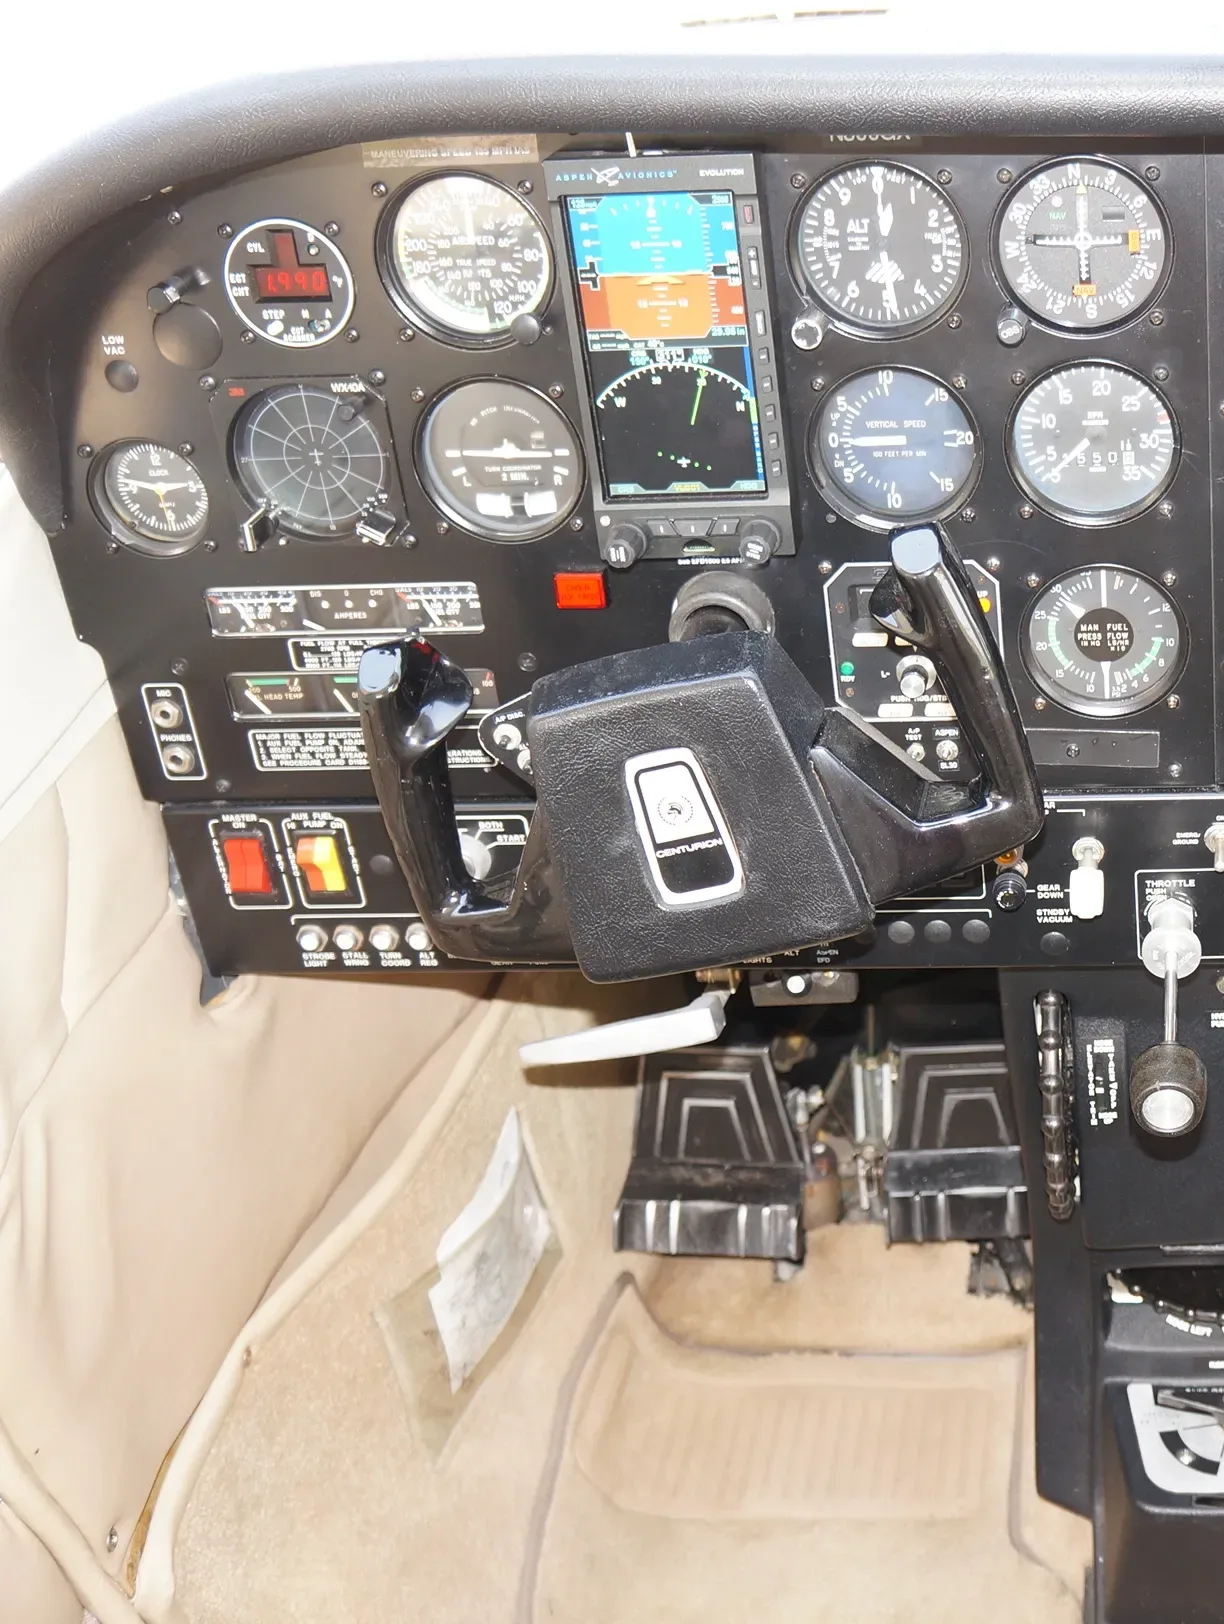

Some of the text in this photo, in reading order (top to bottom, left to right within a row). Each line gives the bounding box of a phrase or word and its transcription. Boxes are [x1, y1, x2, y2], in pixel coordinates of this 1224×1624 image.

[699, 169, 744, 177] EVOLUTION
[847, 218, 869, 233] ALT
[262, 309, 285, 319] STEP
[1001, 327, 1020, 338] OBS
[102, 335, 124, 345] LOW
[104, 347, 125, 356] VAC
[878, 371, 893, 384] 10
[1092, 380, 1111, 396] 20
[934, 388, 949, 401] 15
[1059, 389, 1073, 405] 15
[1122, 396, 1140, 411] 25
[1088, 411, 1103, 419] RPM
[866, 421, 898, 429] VERTICAL
[1042, 414, 1056, 428] 10
[957, 431, 974, 444] 20
[1140, 433, 1159, 449] 30
[1122, 466, 1141, 481] 35
[941, 478, 954, 491] 15
[887, 495, 902, 508] 10
[1162, 604, 1171, 612] 12
[1035, 611, 1047, 620] 25
[1078, 633, 1102, 641] PRESS
[1107, 632, 1129, 640] FLOW
[1036, 642, 1047, 651] 20
[1166, 638, 1175, 646] 10
[1055, 669, 1064, 678] 15
[1086, 684, 1095, 693] 10
[156, 689, 171, 698] MIC
[935, 729, 958, 737] ASPEN
[160, 734, 193, 742] PHONES
[222, 814, 257, 822] MASTER
[291, 812, 334, 821] AUX FUEL
[330, 821, 343, 829] ON
[479, 821, 503, 829] BOTH
[497, 835, 525, 843] START
[656, 838, 723, 858] CENTURION
[1037, 916, 1073, 924] VACUUM
[302, 952, 335, 960] STROBE
[342, 951, 369, 960] STALL
[379, 951, 402, 959] TURN
[304, 959, 328, 967] LIGHT
[344, 959, 370, 967] WRNG
[381, 959, 412, 967] COORD
[420, 959, 439, 967] REG
